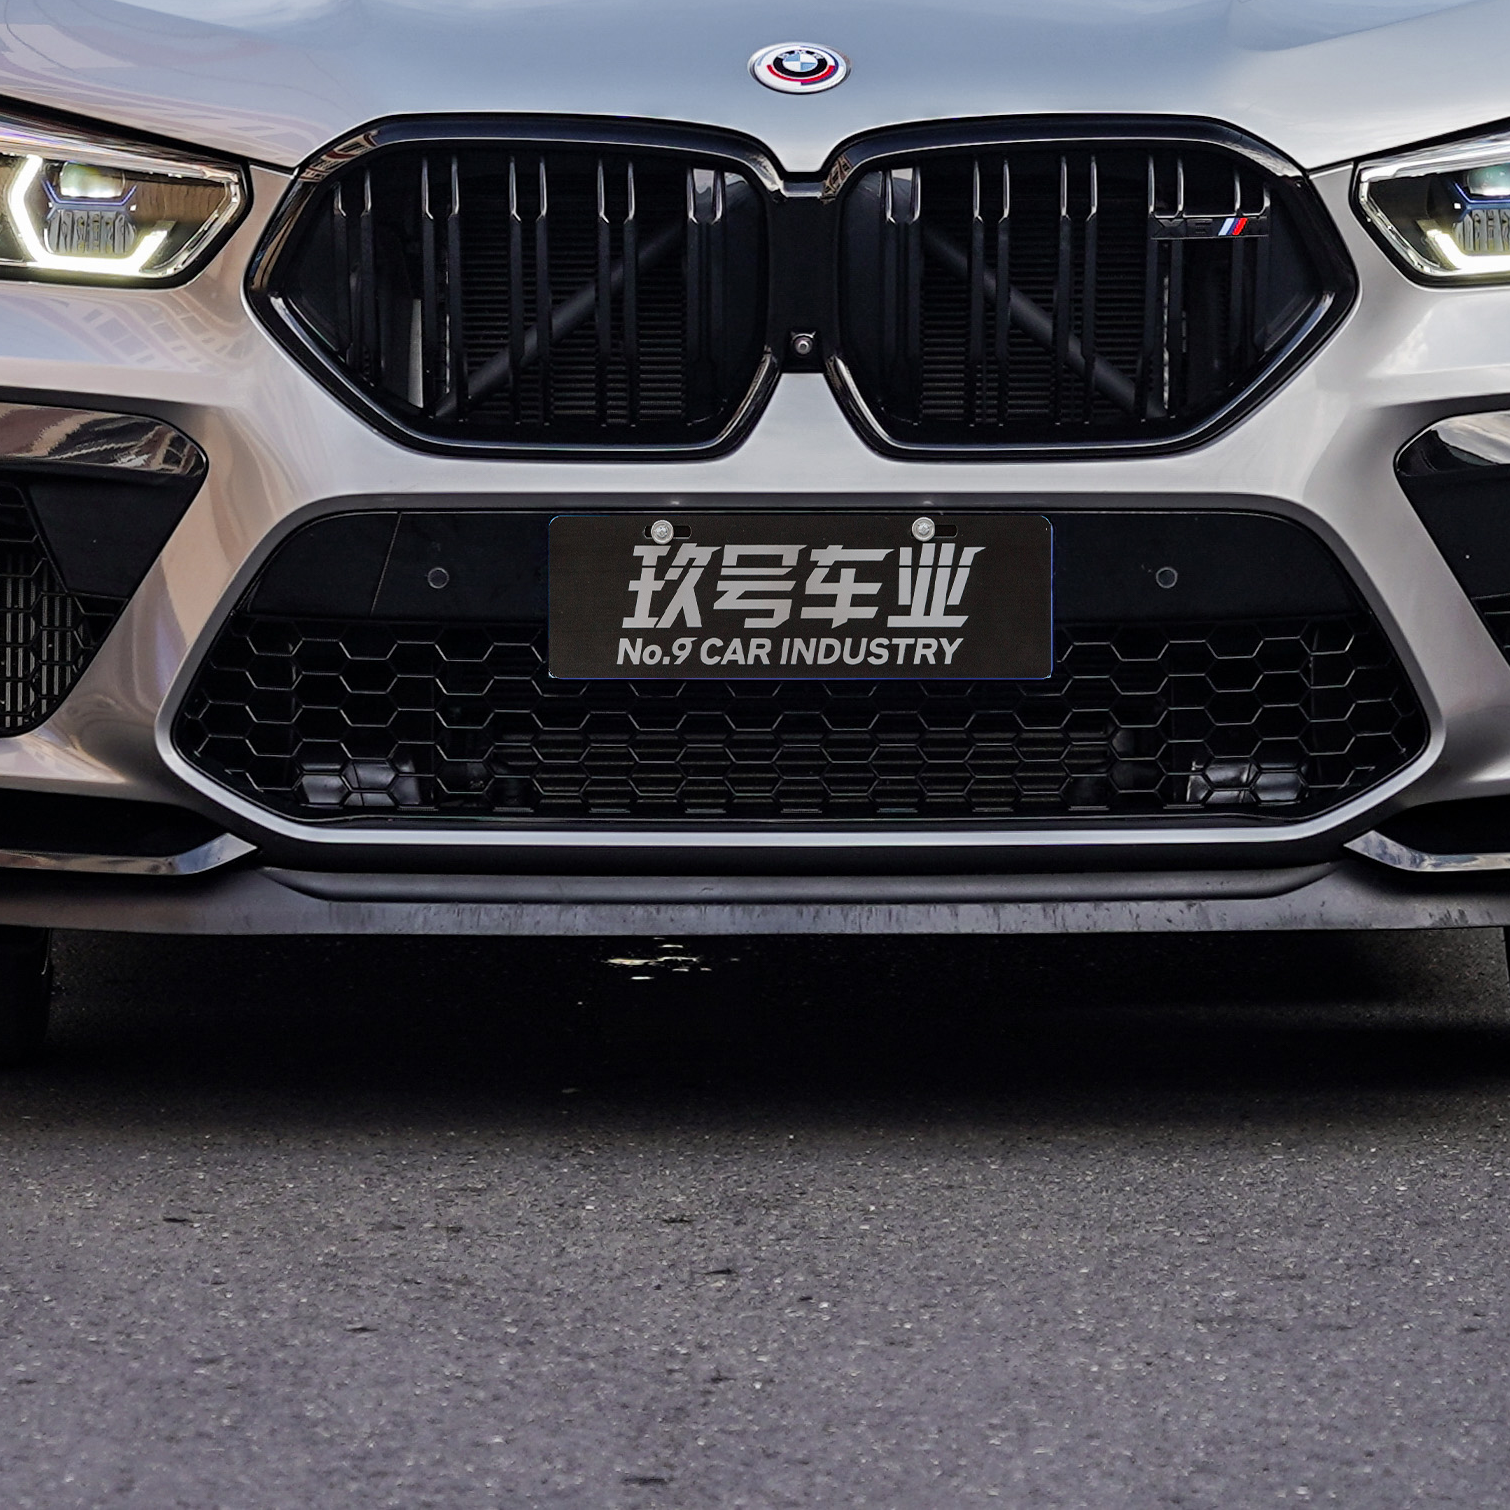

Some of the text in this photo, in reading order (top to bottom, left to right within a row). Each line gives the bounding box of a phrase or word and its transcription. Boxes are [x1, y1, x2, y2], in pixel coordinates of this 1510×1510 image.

[621, 543, 987, 630] 玖号车业
[616, 637, 964, 666] No.9 CAR INDUSTRY
